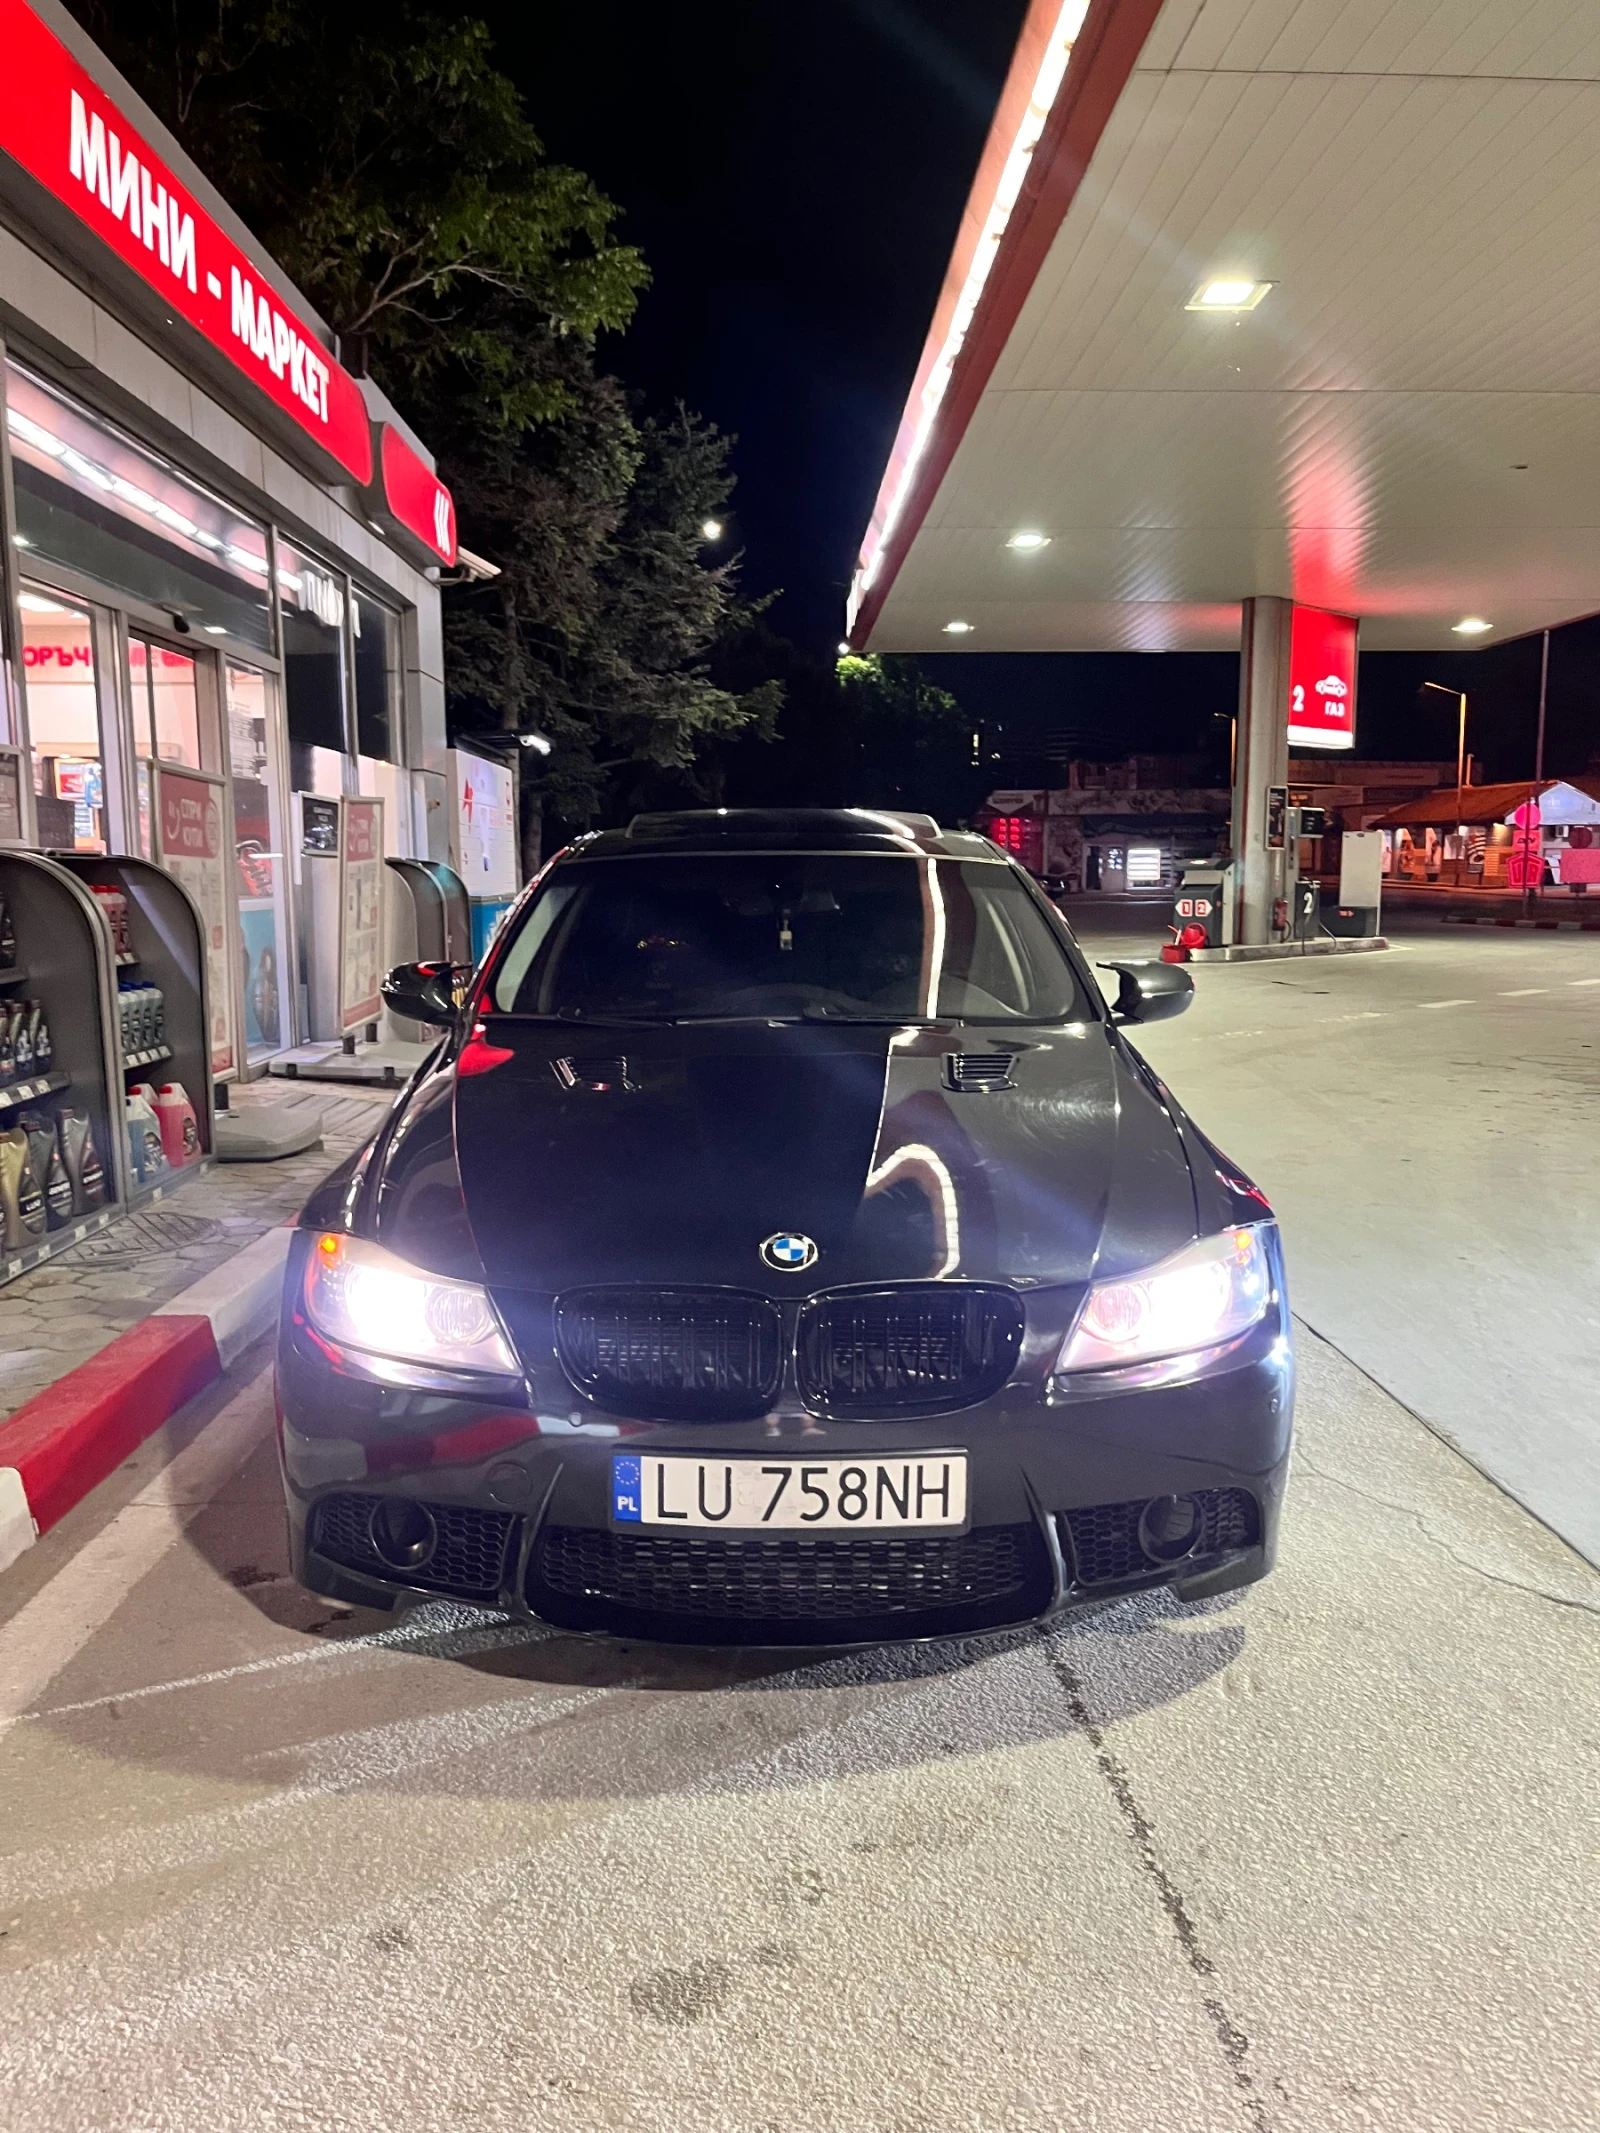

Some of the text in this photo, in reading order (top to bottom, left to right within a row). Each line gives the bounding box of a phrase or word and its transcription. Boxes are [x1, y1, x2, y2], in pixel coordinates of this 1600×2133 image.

[70, 89, 197, 295] МИНИ
[231, 265, 330, 423] МАРКЕТ
[1293, 684, 1305, 712] 2
[1325, 701, 1345, 717] ГАЗ
[1303, 892, 1313, 914] 2
[617, 1496, 638, 1512] PL
[657, 1463, 950, 1522] LU 758NH
